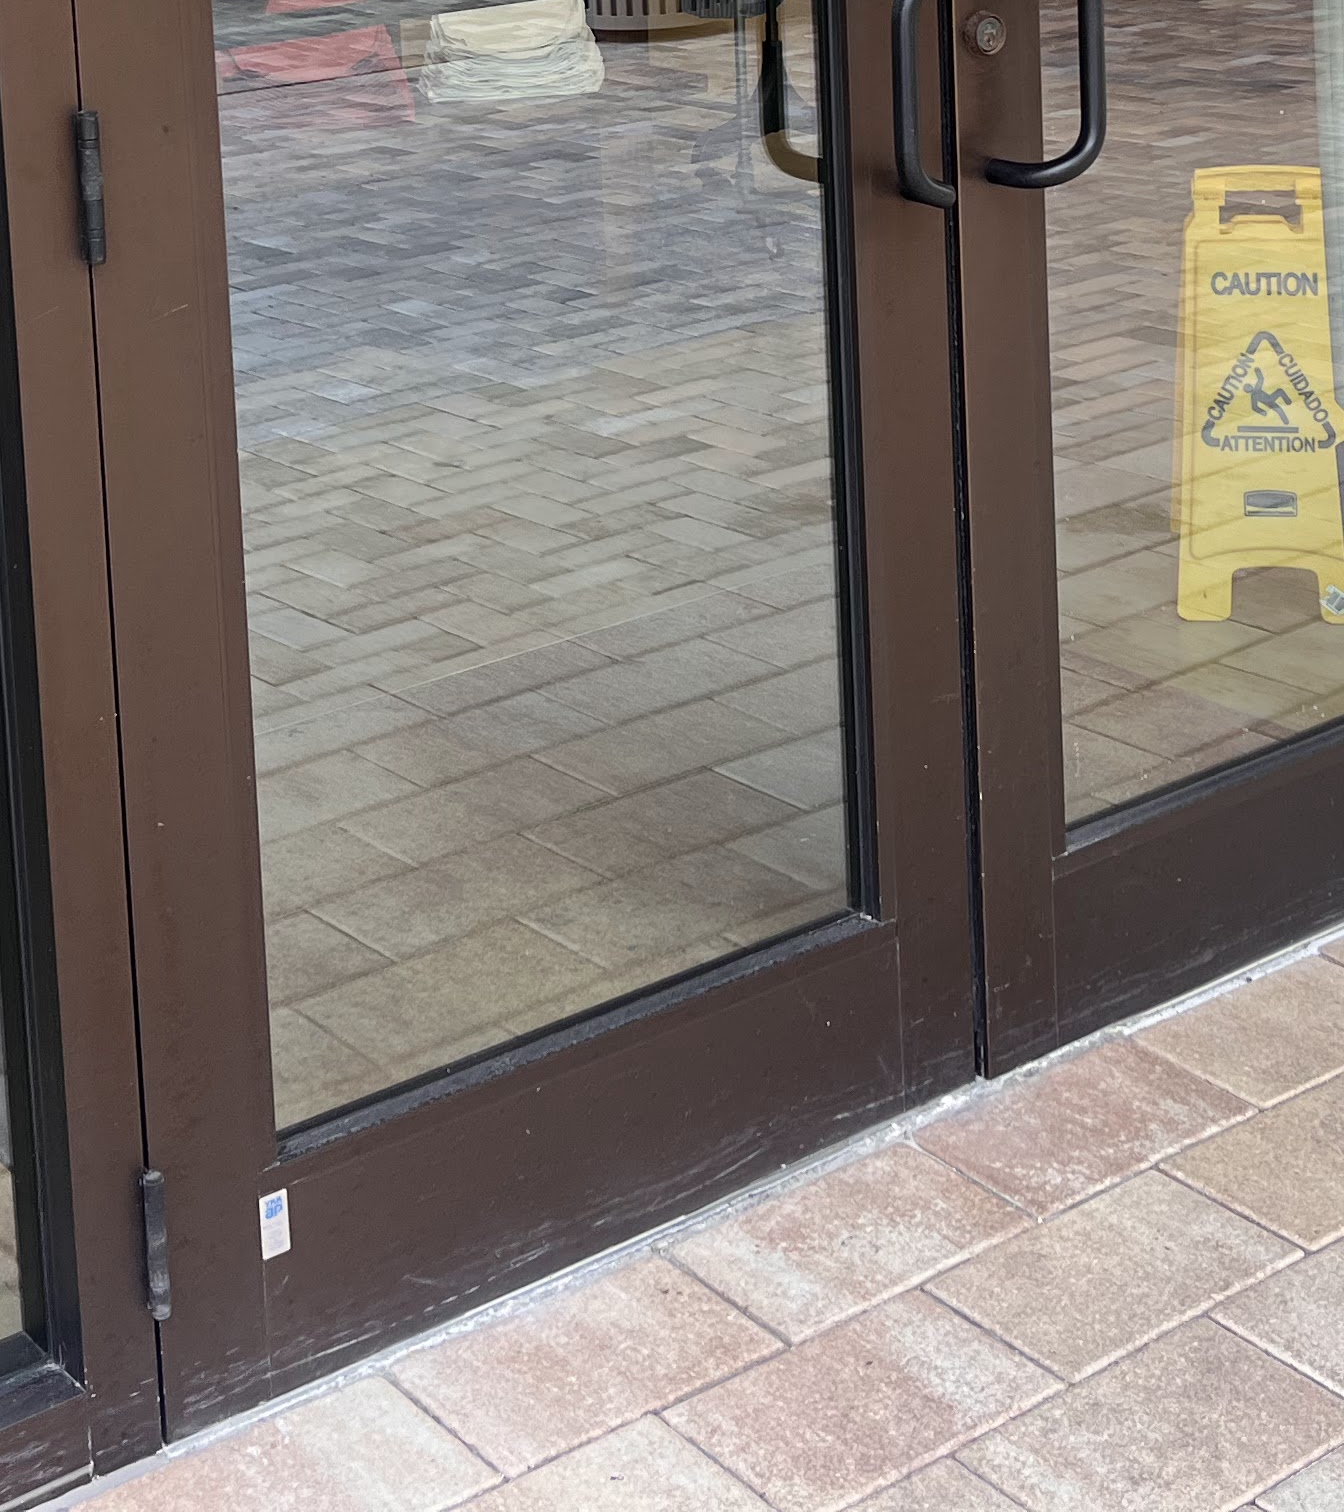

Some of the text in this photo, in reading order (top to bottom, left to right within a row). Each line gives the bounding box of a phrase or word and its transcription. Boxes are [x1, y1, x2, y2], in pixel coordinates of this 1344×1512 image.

[1210, 271, 1319, 296] CAUTION
[1207, 352, 1255, 421] CAUTION
[1278, 353, 1329, 423] CUIDADO
[1220, 435, 1316, 453] ATTENTION
